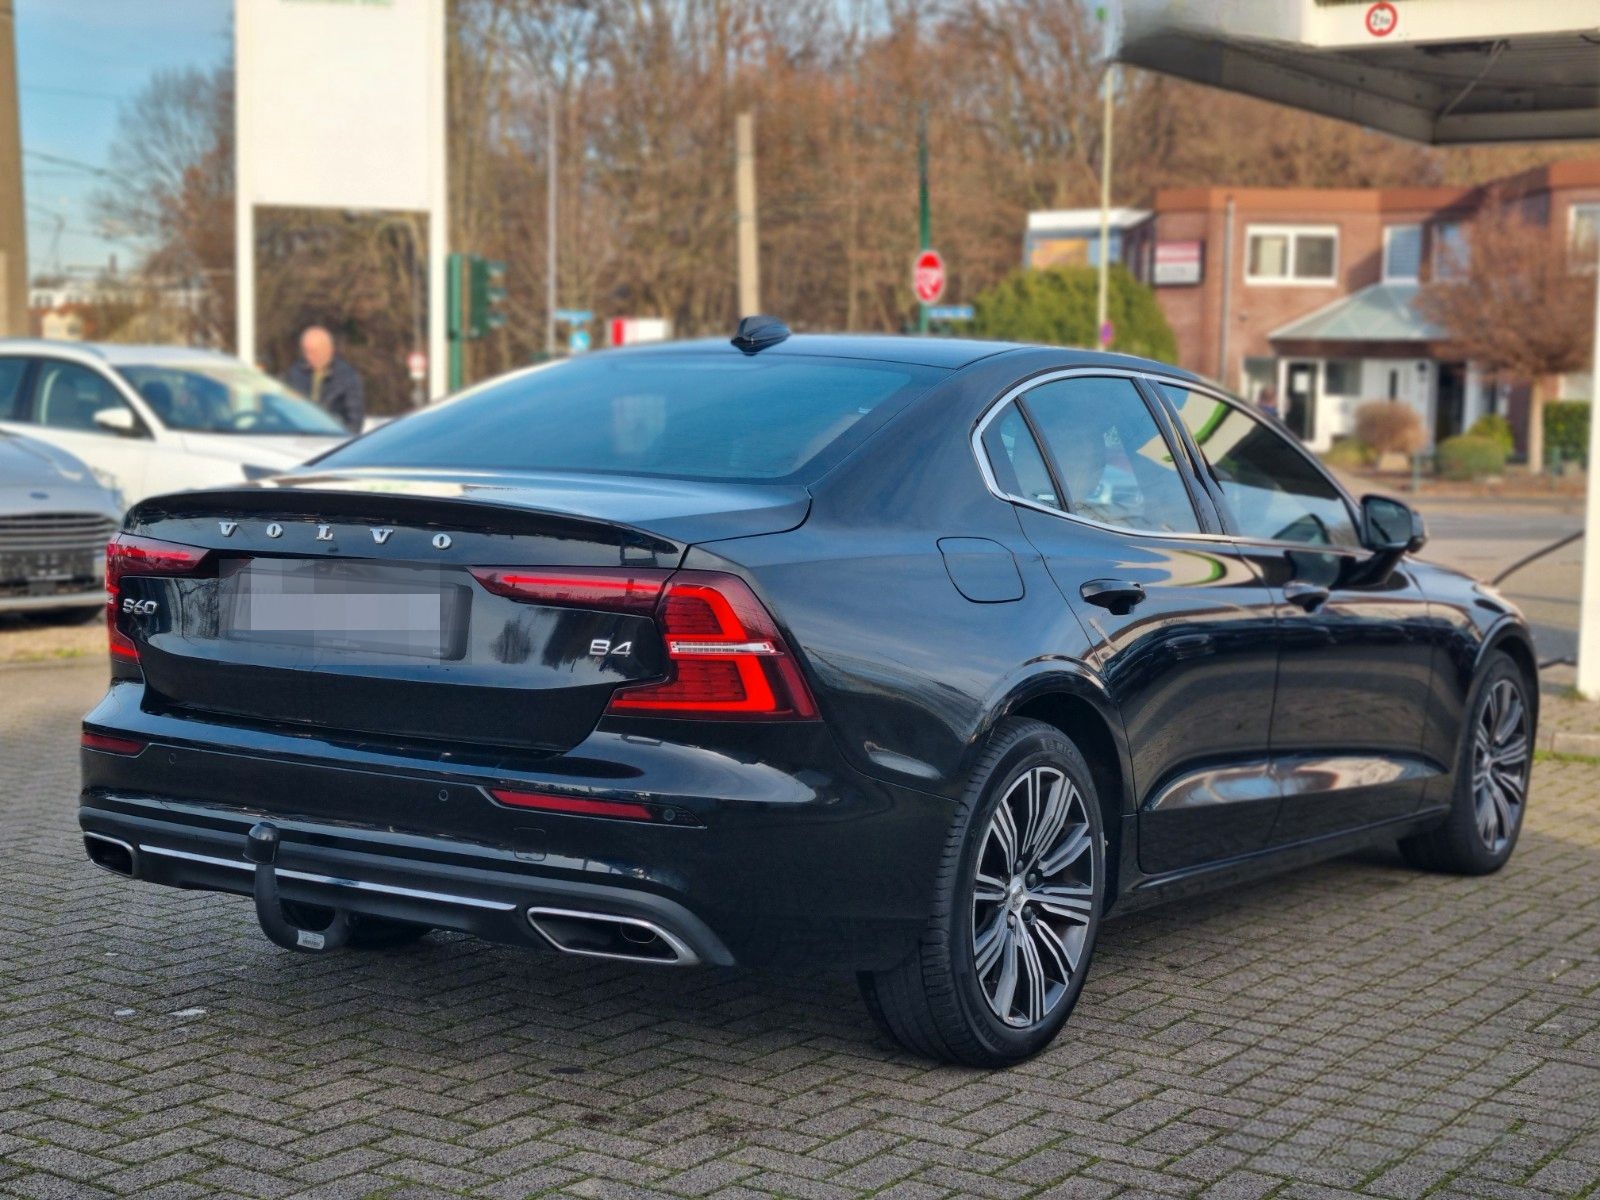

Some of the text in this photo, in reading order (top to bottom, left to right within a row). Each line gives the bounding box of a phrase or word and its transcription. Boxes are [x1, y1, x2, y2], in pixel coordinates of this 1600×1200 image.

[219, 521, 453, 550] VOLVO
[122, 598, 158, 615] S60
[589, 639, 632, 657] B4
